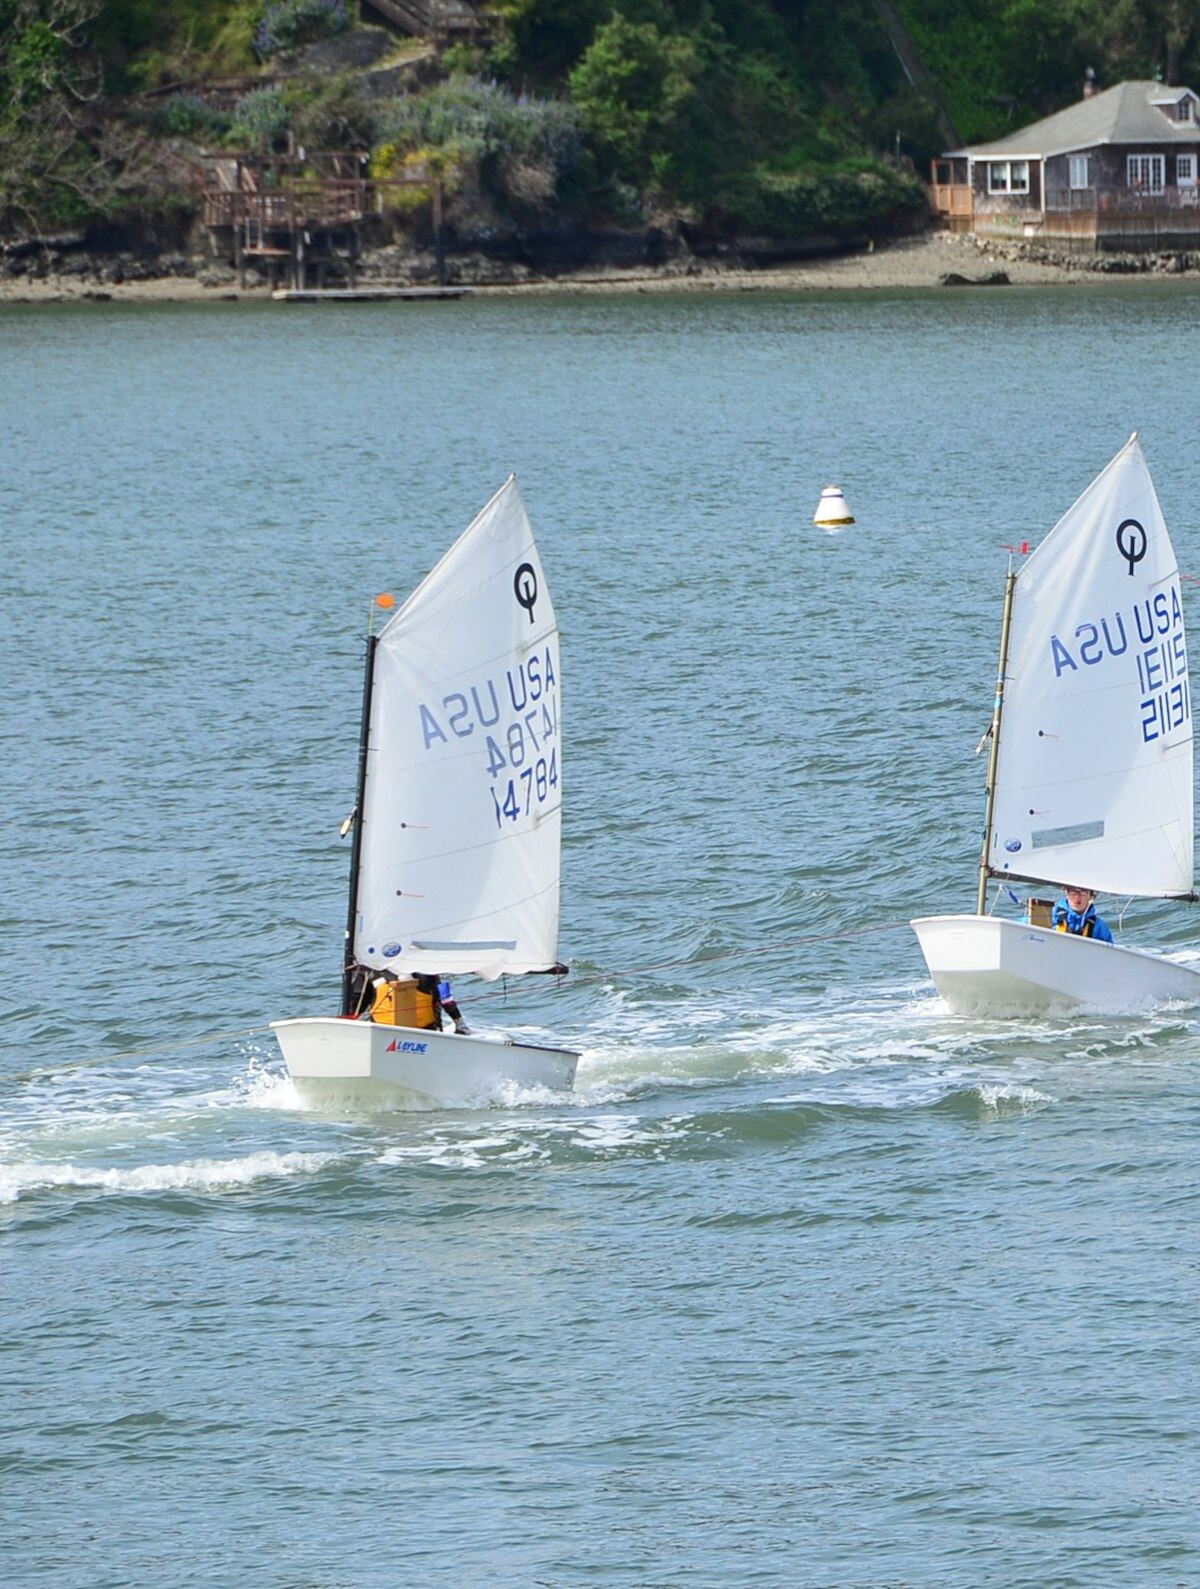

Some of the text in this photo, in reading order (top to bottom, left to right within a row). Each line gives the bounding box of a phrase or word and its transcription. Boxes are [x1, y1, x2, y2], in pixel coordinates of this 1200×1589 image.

[1134, 586, 1182, 644] USA
[506, 646, 556, 711] USA
[1140, 680, 1189, 743] 21131
[490, 747, 558, 829] 14784
